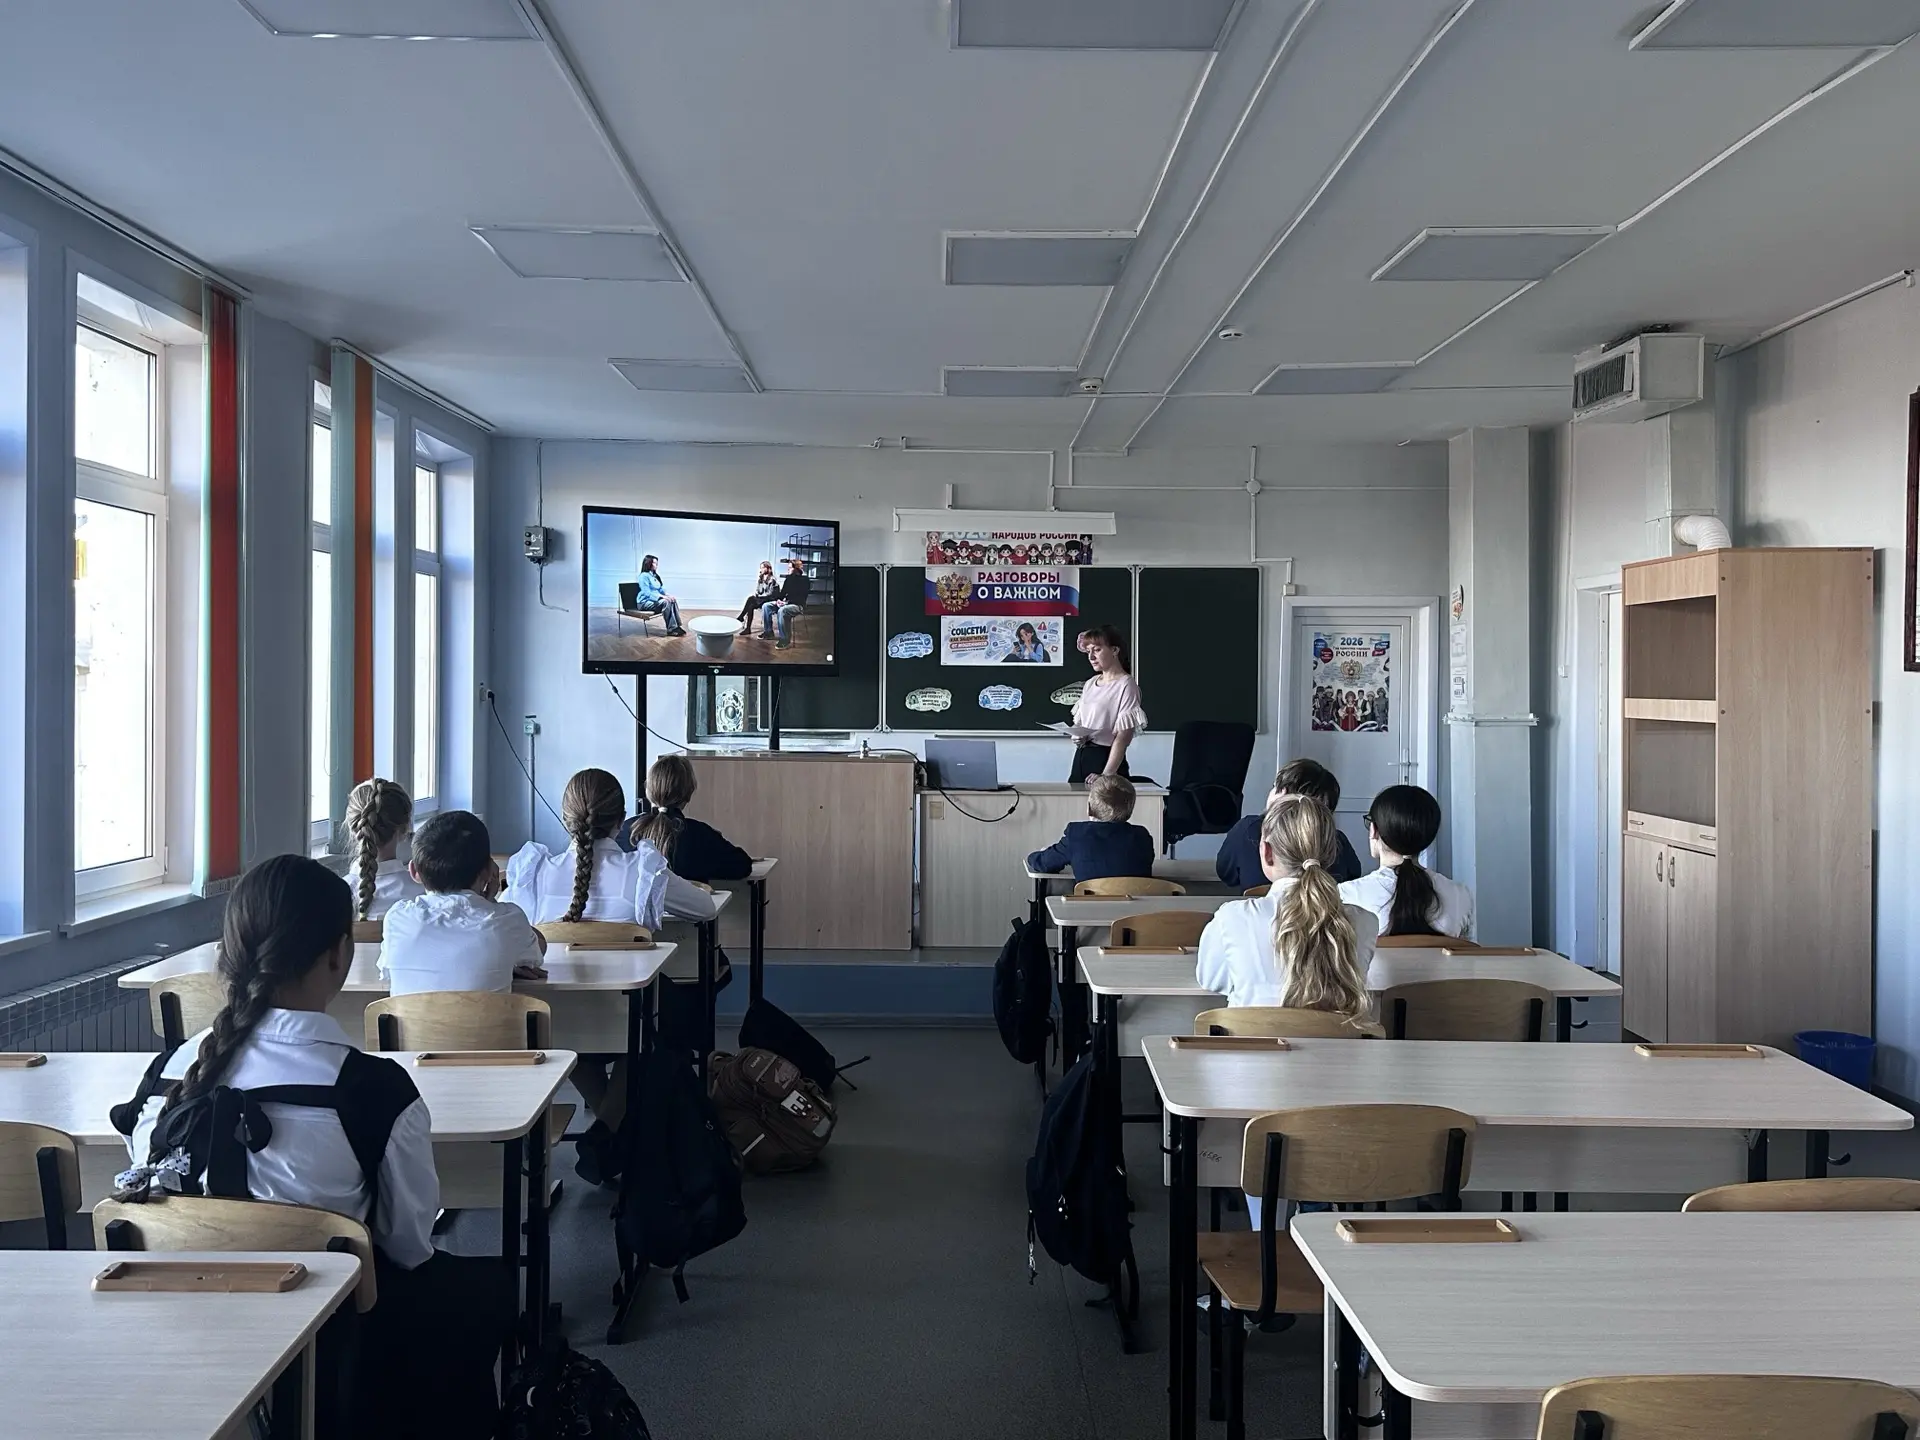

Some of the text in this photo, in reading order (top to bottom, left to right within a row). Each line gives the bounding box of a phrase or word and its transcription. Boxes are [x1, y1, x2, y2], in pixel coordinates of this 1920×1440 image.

[978, 572, 1060, 583] РАЗГОВОРЫ
[977, 586, 1061, 600] О ВАЖНОМ
[1340, 637, 1363, 646] 2026
